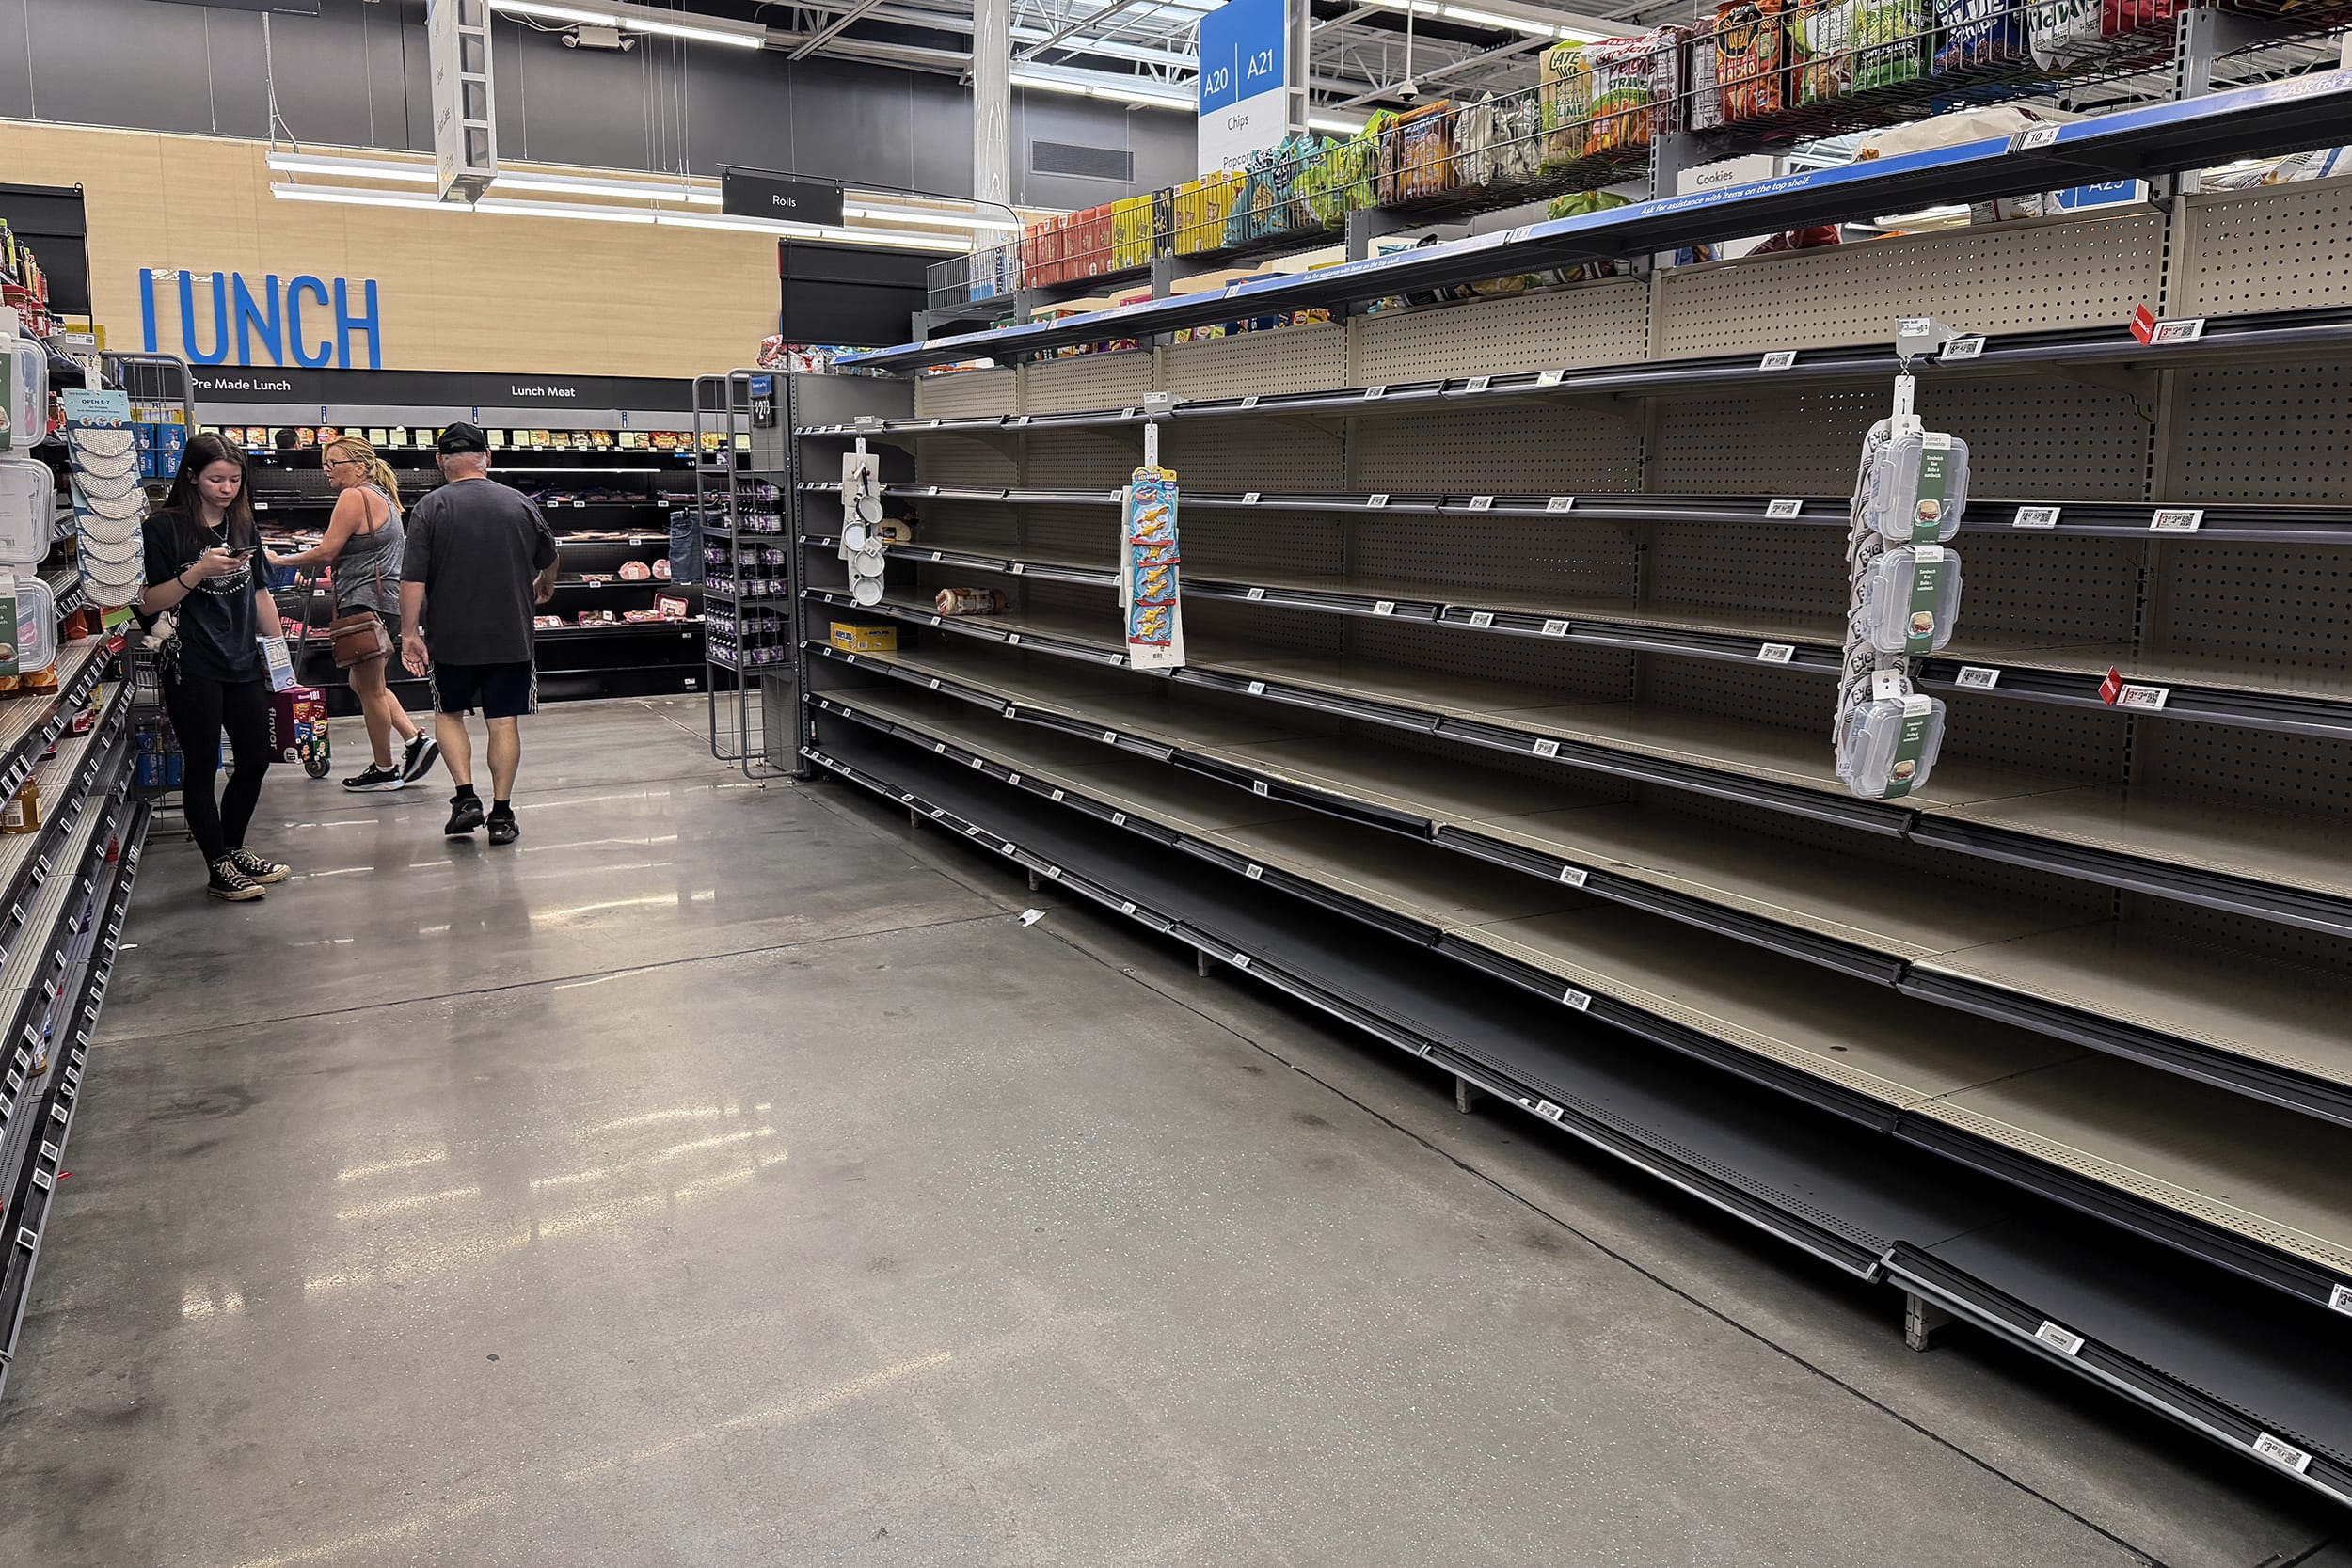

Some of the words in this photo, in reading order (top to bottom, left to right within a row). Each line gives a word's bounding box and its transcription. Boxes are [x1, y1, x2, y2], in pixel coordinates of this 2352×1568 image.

[1248, 49, 1273, 79] A21
[1549, 51, 1581, 71] LATE
[1204, 68, 1229, 98] A20
[2285, 82, 2313, 97] Ask
[2315, 79, 2340, 92] for
[1227, 114, 1249, 131] Chips
[2030, 131, 2042, 142] 10
[1696, 171, 1733, 185] Cookies
[772, 195, 797, 208] Rolls
[1641, 205, 1654, 214] Ask
[1656, 203, 1667, 214] for
[1667, 198, 1704, 211] assistance
[1705, 192, 1722, 203] with
[1722, 188, 1744, 199] items
[1757, 183, 1771, 193] the
[1772, 182, 1786, 192] top
[139, 268, 381, 369] LUNCH
[192, 378, 211, 389] Pre
[215, 378, 250, 391] Made
[254, 380, 292, 391] Lunch
[512, 385, 545, 397] Lunch
[548, 386, 576, 398] Meat
[268, 707, 277, 750] flavor
